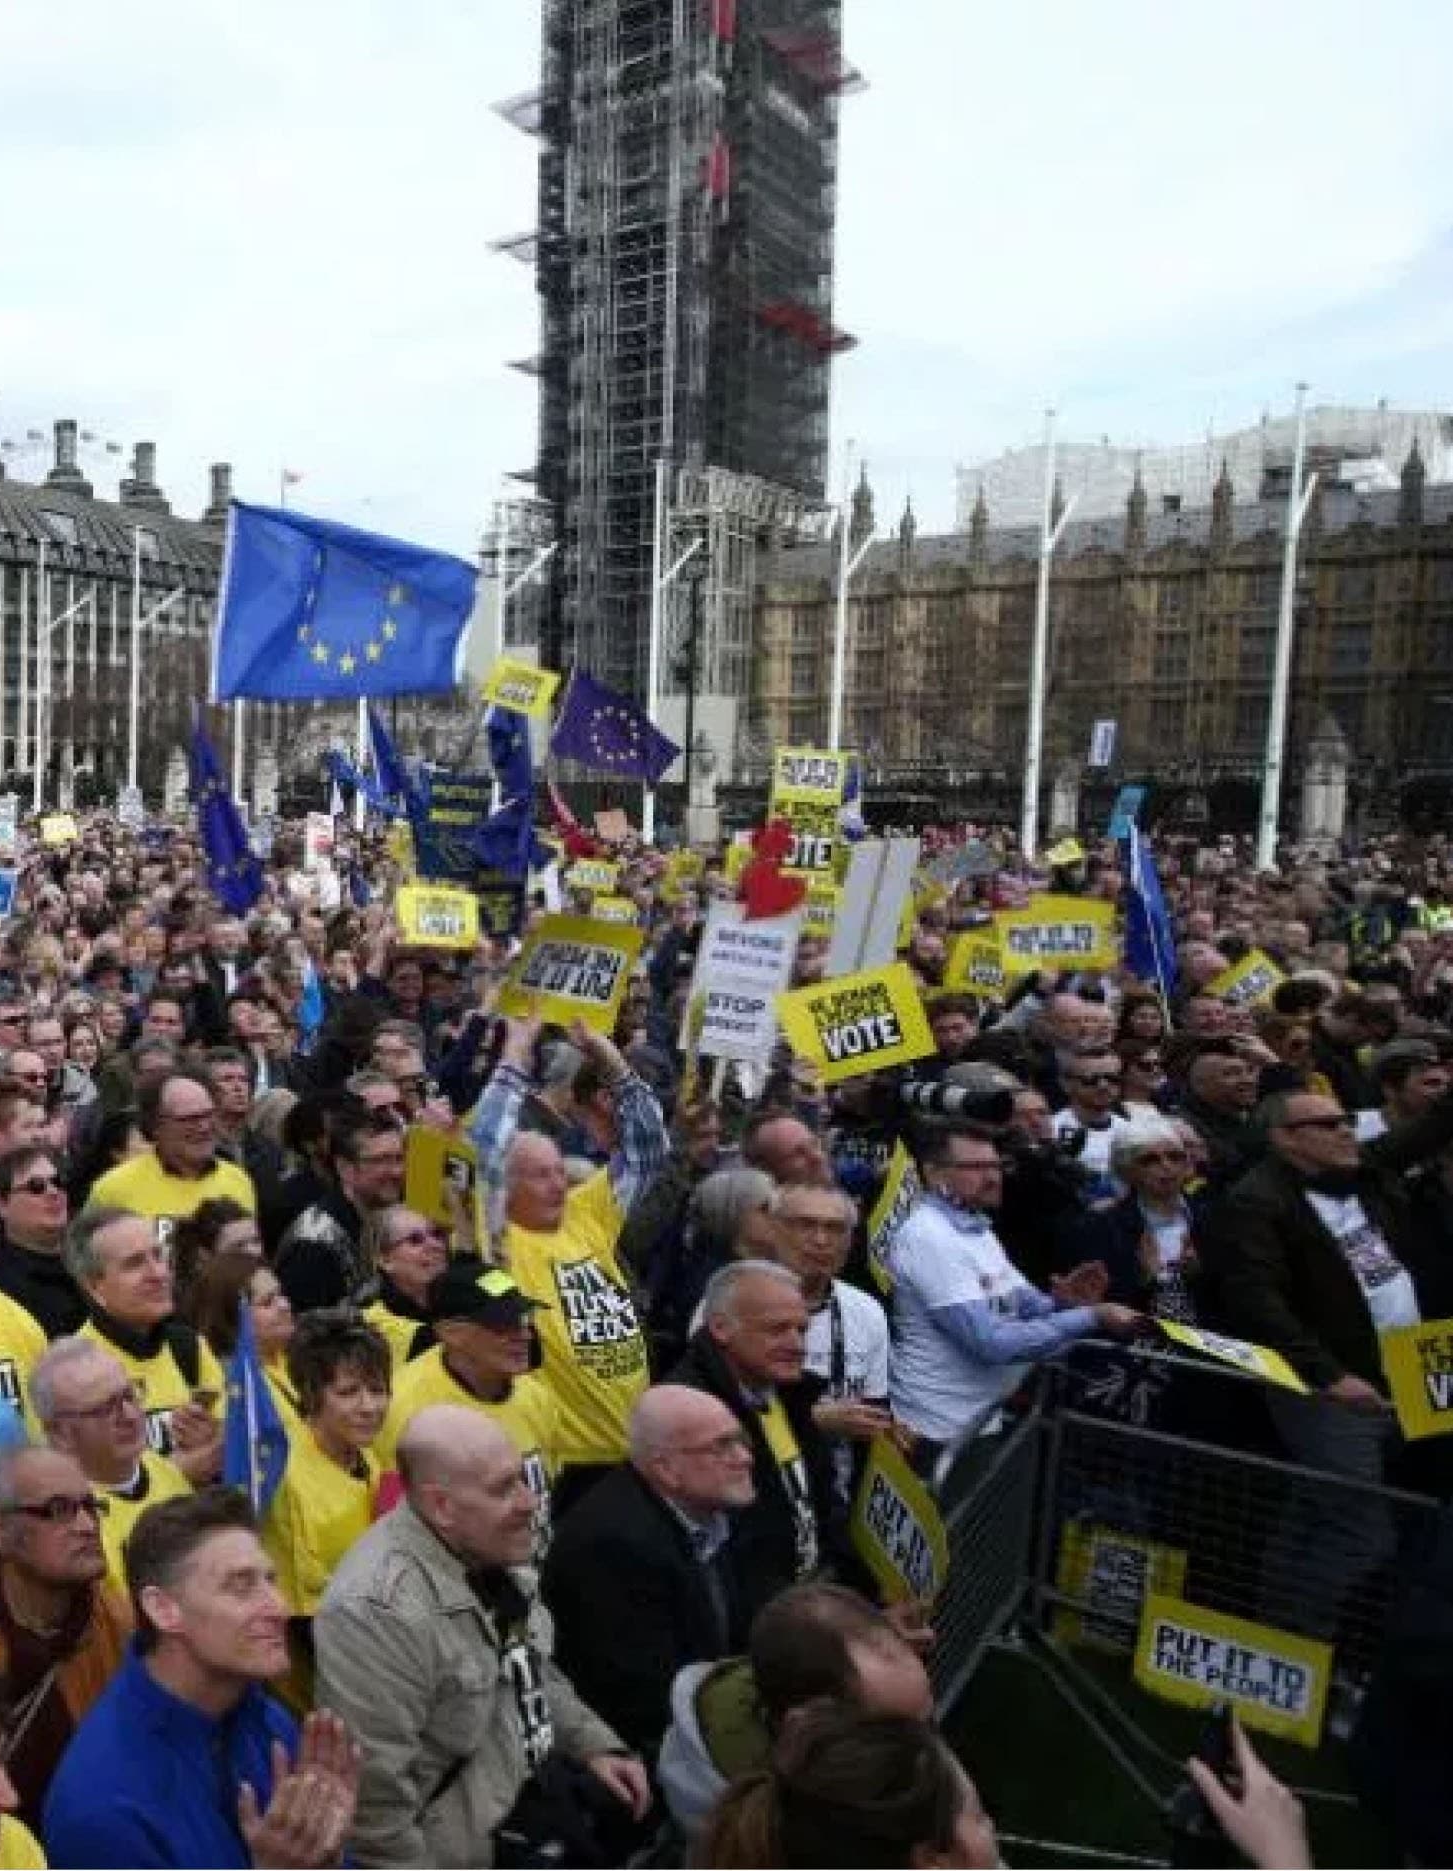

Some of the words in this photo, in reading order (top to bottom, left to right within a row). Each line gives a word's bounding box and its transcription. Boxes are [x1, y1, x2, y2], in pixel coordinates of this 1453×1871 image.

[709, 992, 765, 1014] STOP
[822, 1012, 901, 1061] VOTE
[1156, 1625, 1217, 1664] PUT
[1226, 1645, 1255, 1675] IT
[1268, 1658, 1306, 1691] TO
[1156, 1651, 1198, 1680] THE
[1206, 1665, 1295, 1710] PEOPLE
